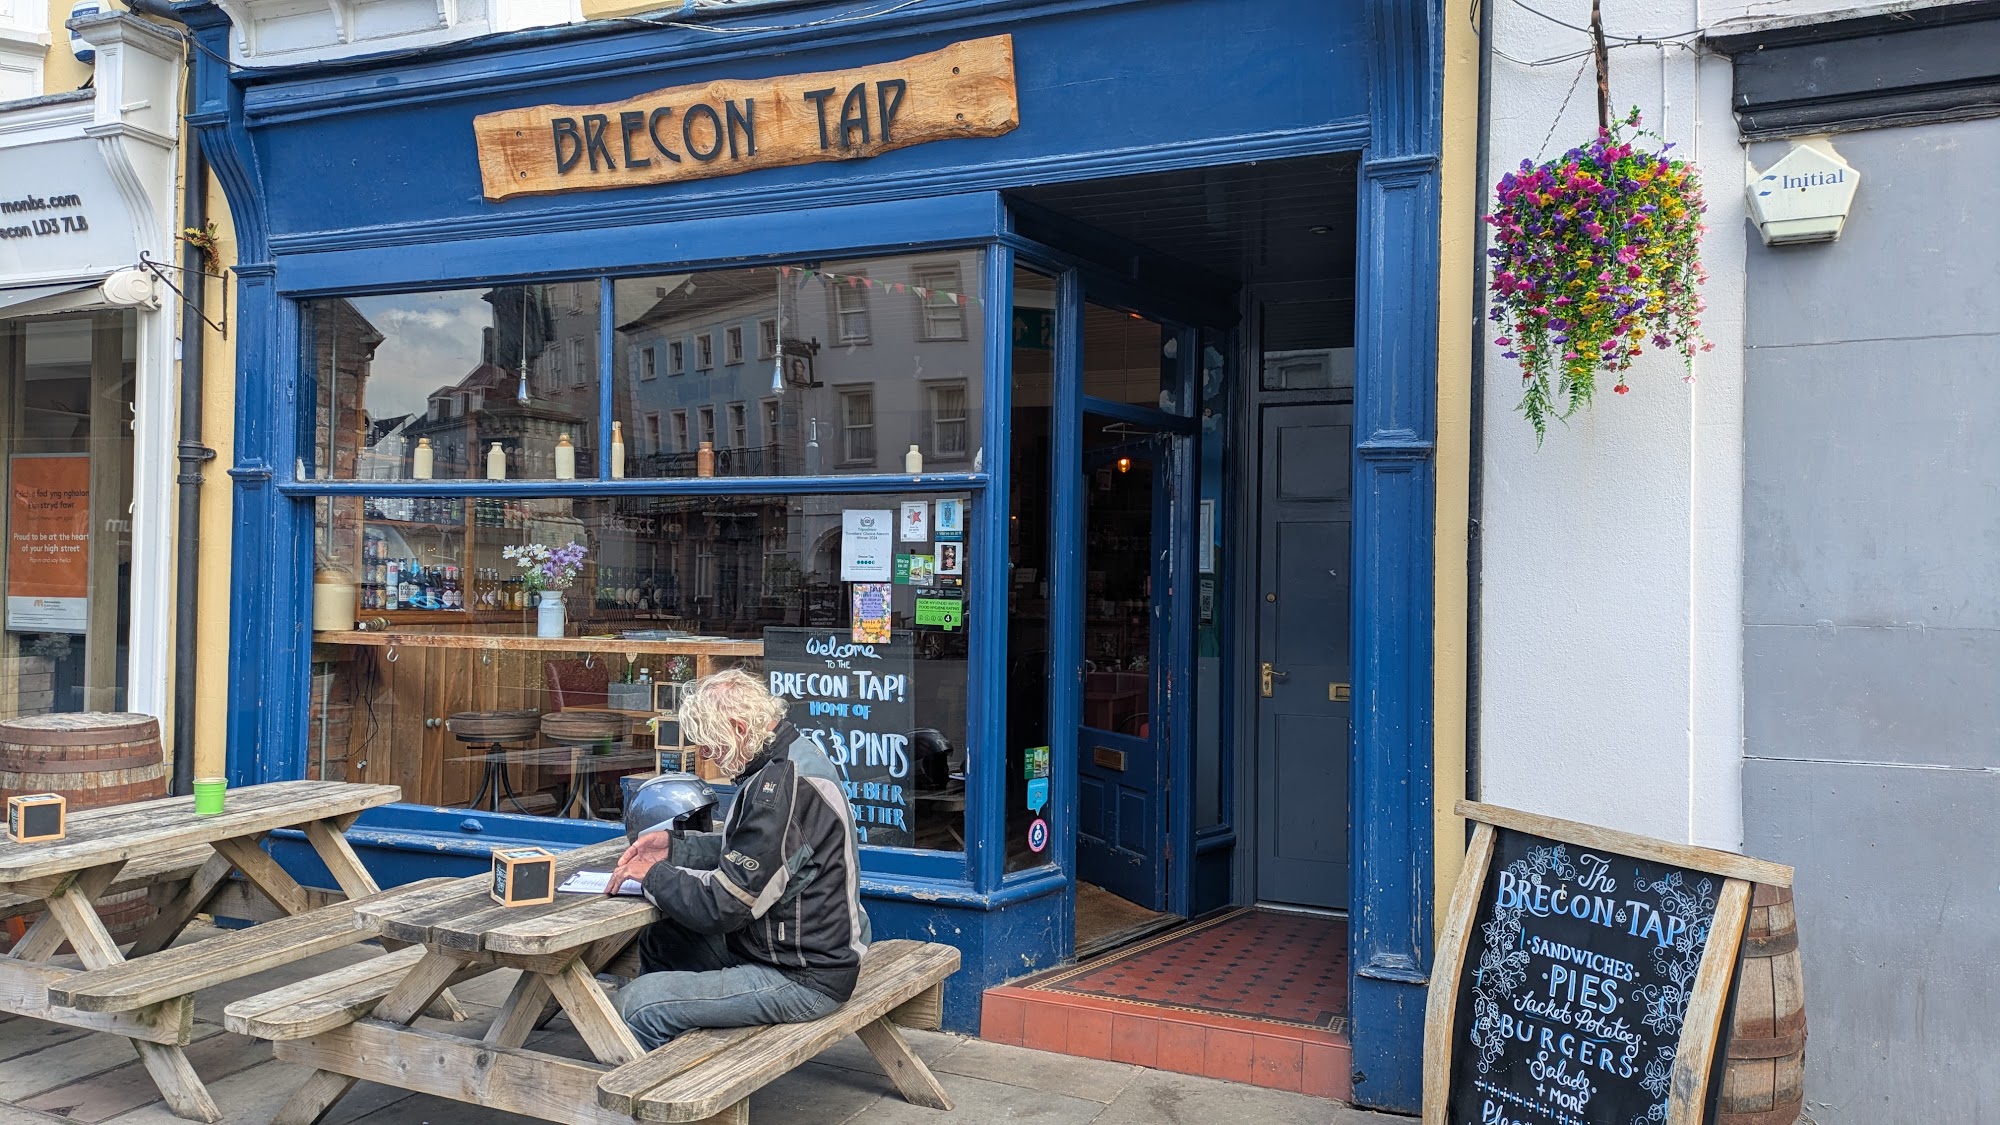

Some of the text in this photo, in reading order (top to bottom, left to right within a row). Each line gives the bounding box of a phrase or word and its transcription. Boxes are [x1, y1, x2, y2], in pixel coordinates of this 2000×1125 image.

[551, 78, 906, 175] BRECON TAP
[1782, 169, 1844, 189] Initial
[0, 194, 81, 213] monbs.com
[32, 218, 60, 235] LD3
[60, 215, 89, 232] 7LB
[14, 533, 31, 541] Proud
[72, 532, 89, 541] heart
[22, 544, 80, 554] of your high street
[806, 636, 882, 659] Welcome
[825, 659, 851, 669] TO THE
[770, 671, 906, 703] BRECON TAP!
[809, 701, 872, 720] HOME OF
[849, 729, 910, 778] PINTS
[1577, 853, 1617, 893] The
[1496, 871, 1687, 948] BRECON TAP
[1531, 935, 1634, 982] SANDWICHES
[1550, 964, 1618, 1014] PIES
[1513, 990, 1642, 1058] Jacket Potatoes
[1500, 1013, 1633, 1078] BURGERS
[1530, 1051, 1590, 1103] Salads
[1550, 1087, 1585, 1115] MORE
